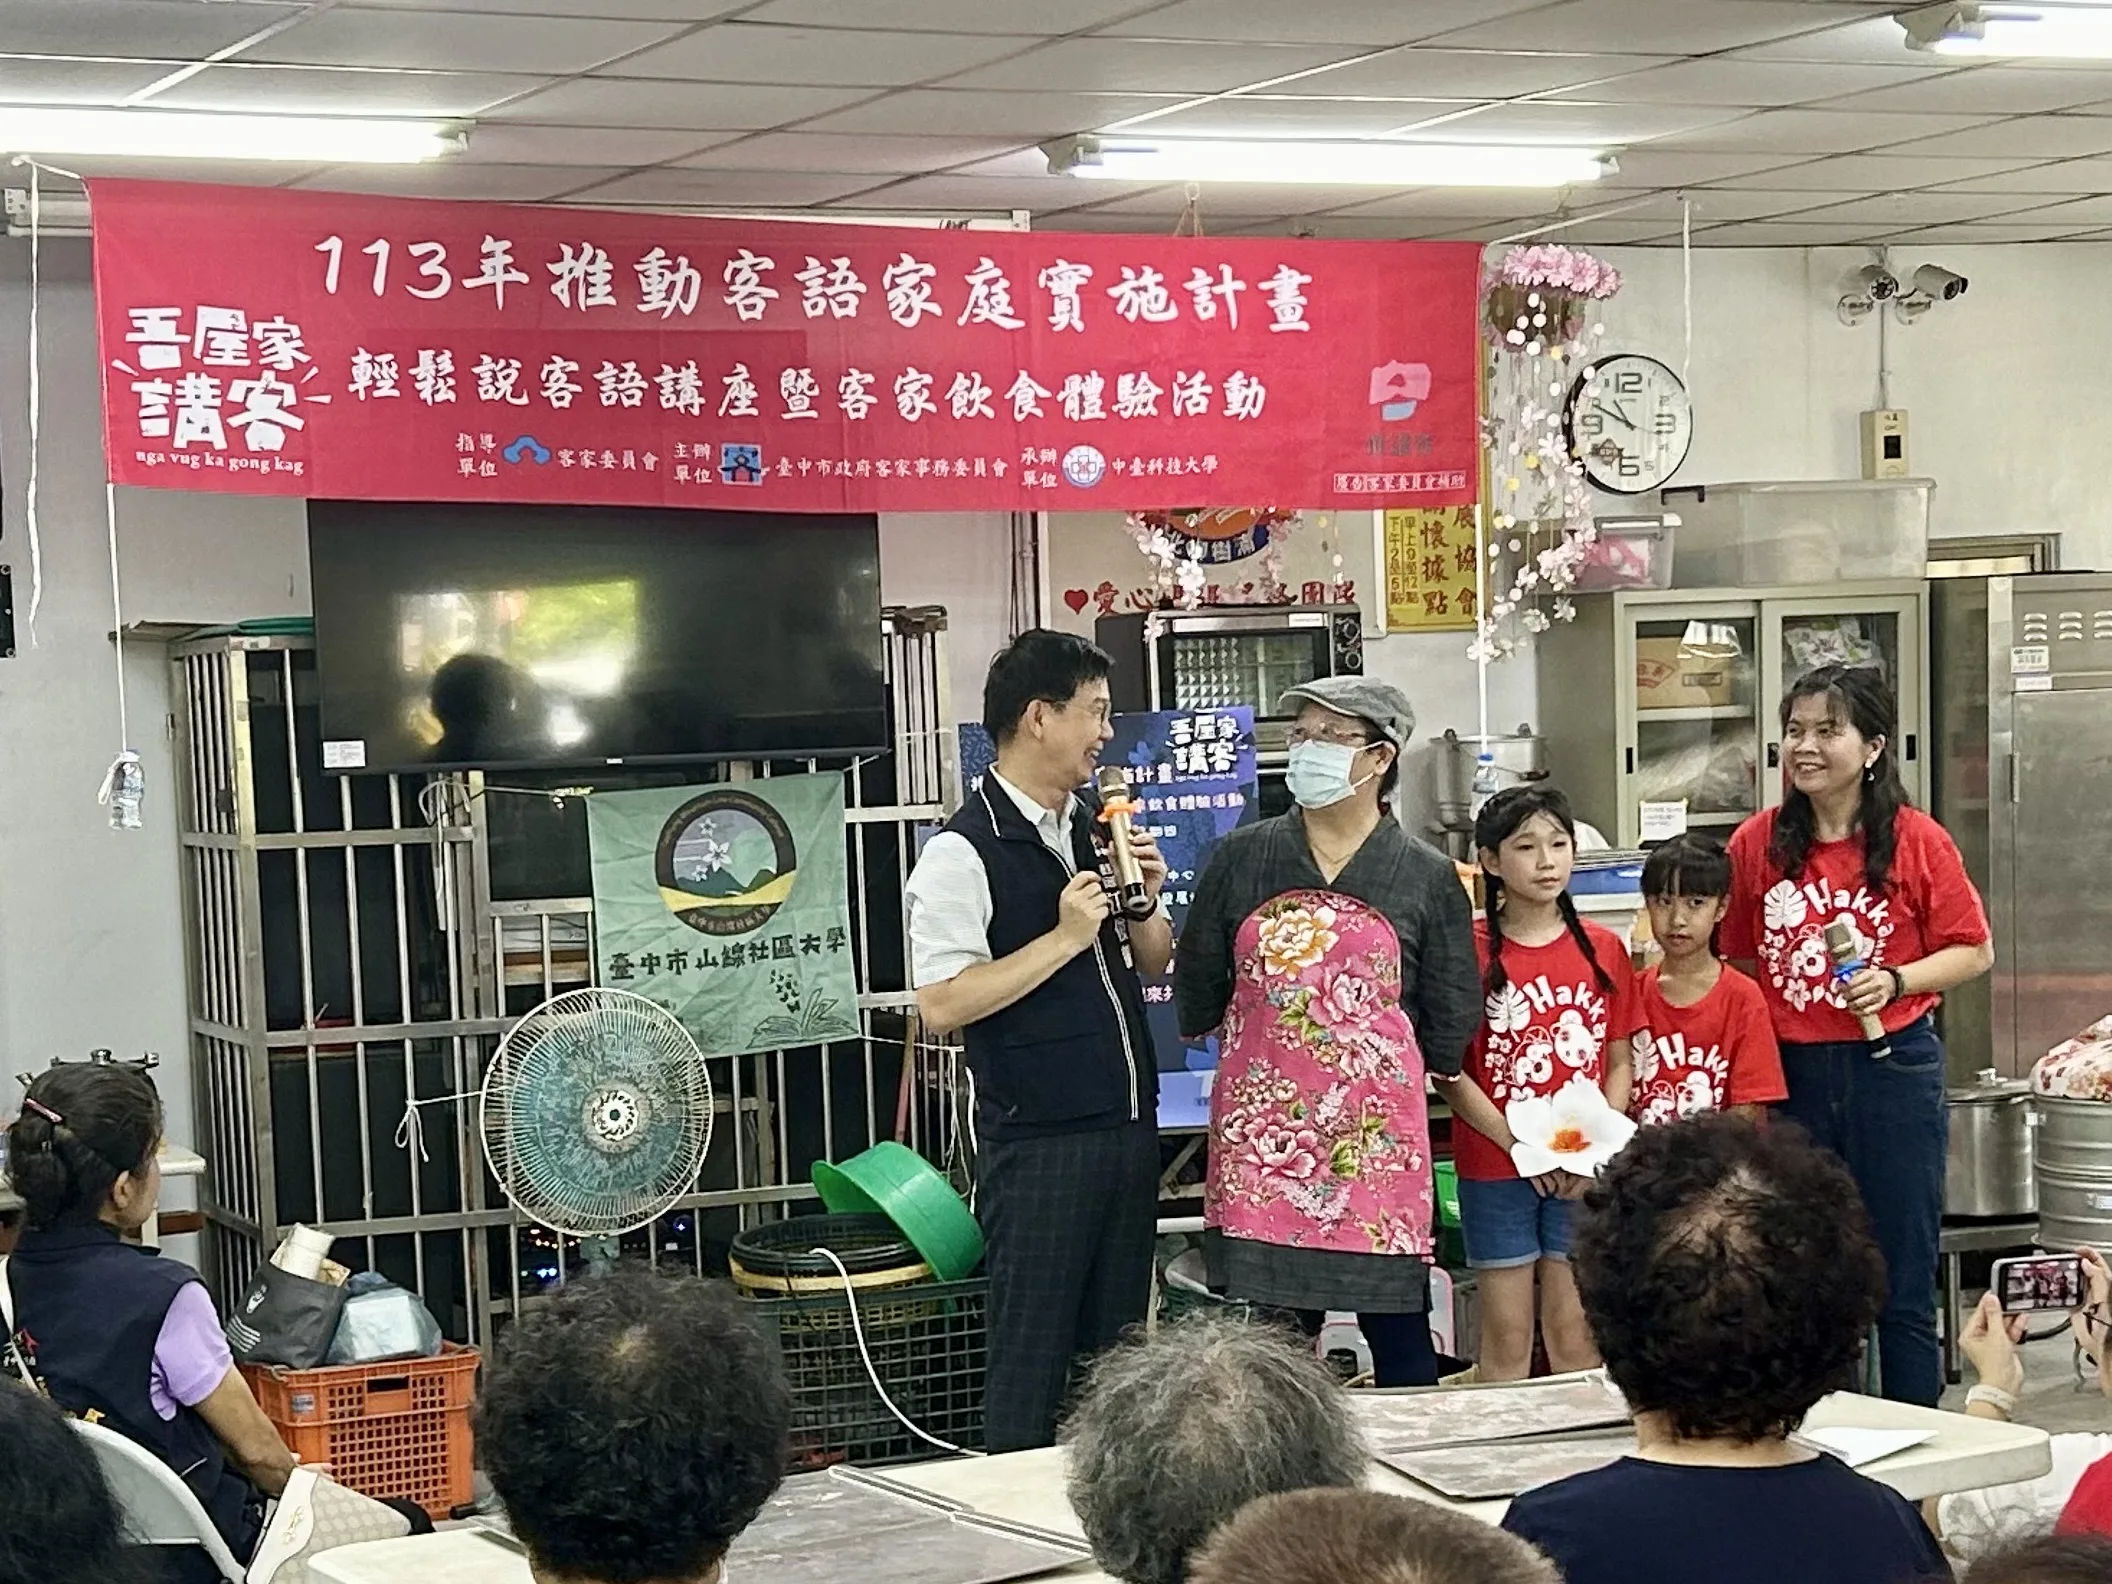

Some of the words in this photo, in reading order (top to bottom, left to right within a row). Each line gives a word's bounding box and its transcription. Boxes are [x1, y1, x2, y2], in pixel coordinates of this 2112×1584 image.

[314, 234, 1312, 333] 113年推動客語家庭實施計畫
[125, 305, 312, 371] 吾屋家
[348, 345, 1268, 424] 輕鬆說客語講座暨客家飲食體驗活動
[1614, 372, 1642, 393] 12
[130, 370, 305, 452] 講客
[455, 432, 497, 454] 指導
[674, 441, 712, 461] 主辦
[136, 451, 166, 466] nga
[170, 454, 201, 469] vug
[204, 452, 225, 467] ka
[228, 458, 271, 474] gong
[274, 456, 304, 475] kag
[456, 456, 498, 478] 單位
[557, 448, 659, 472] 客家委員會
[775, 456, 1008, 478] 臺中市政府客家事務委員會
[1020, 446, 1058, 467] 承辦
[1111, 453, 1219, 477] 中臺科技大學
[674, 464, 713, 485] 單位
[1021, 468, 1058, 489] 單位
[1420, 508, 1450, 617] 懷據點
[608, 925, 848, 981] 臺中市山線社區大學
